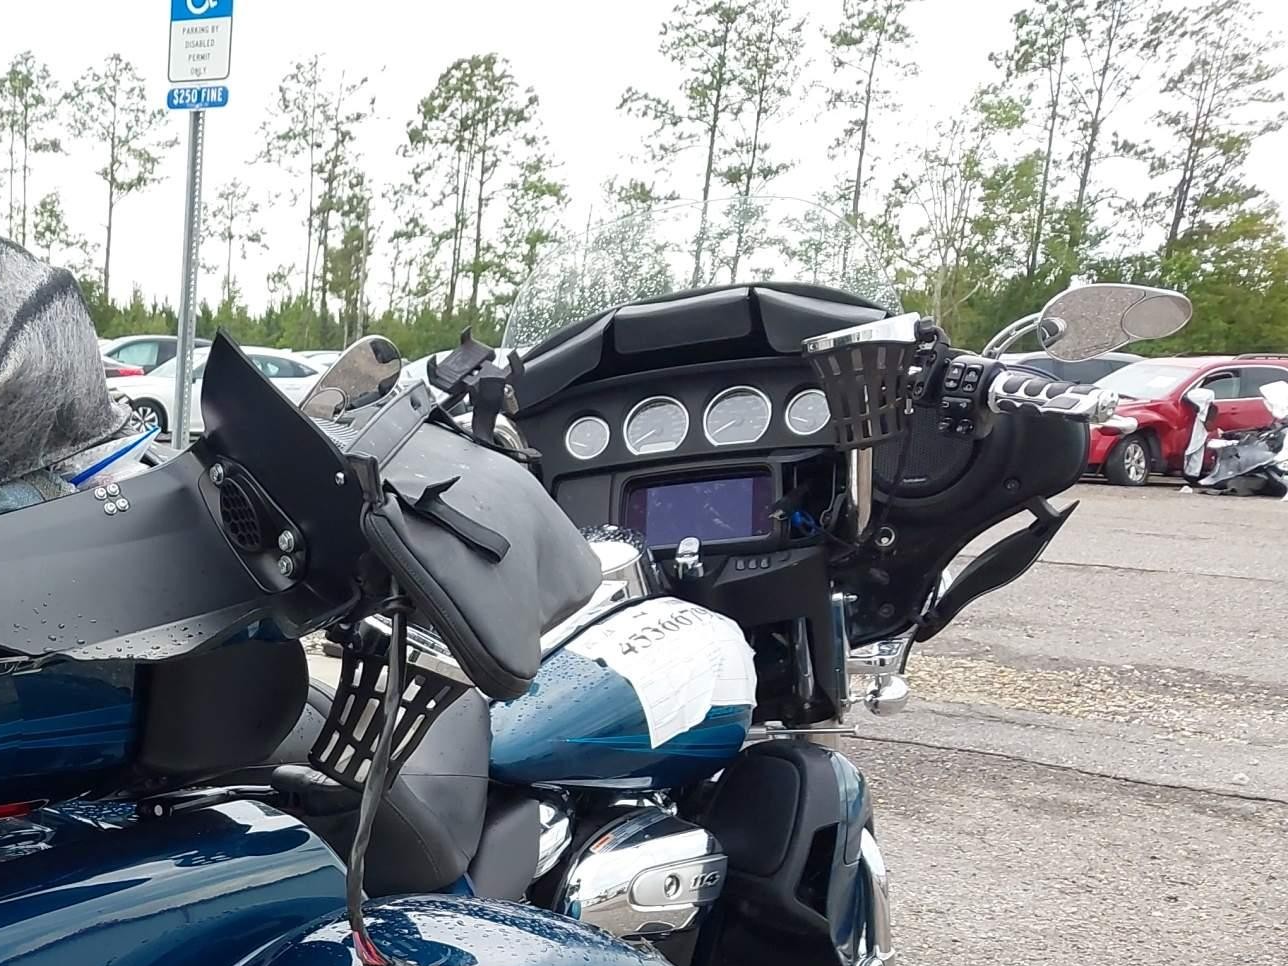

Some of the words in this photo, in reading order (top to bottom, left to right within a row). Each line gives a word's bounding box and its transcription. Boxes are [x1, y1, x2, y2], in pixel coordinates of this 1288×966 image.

[182, 25, 209, 35] PARKING
[211, 25, 219, 33] BY
[184, 39, 215, 49] DISABLED
[188, 53, 211, 62] PERMIT
[190, 67, 207, 76] ONLY
[173, 88, 198, 106] $250
[200, 87, 223, 103] FINE
